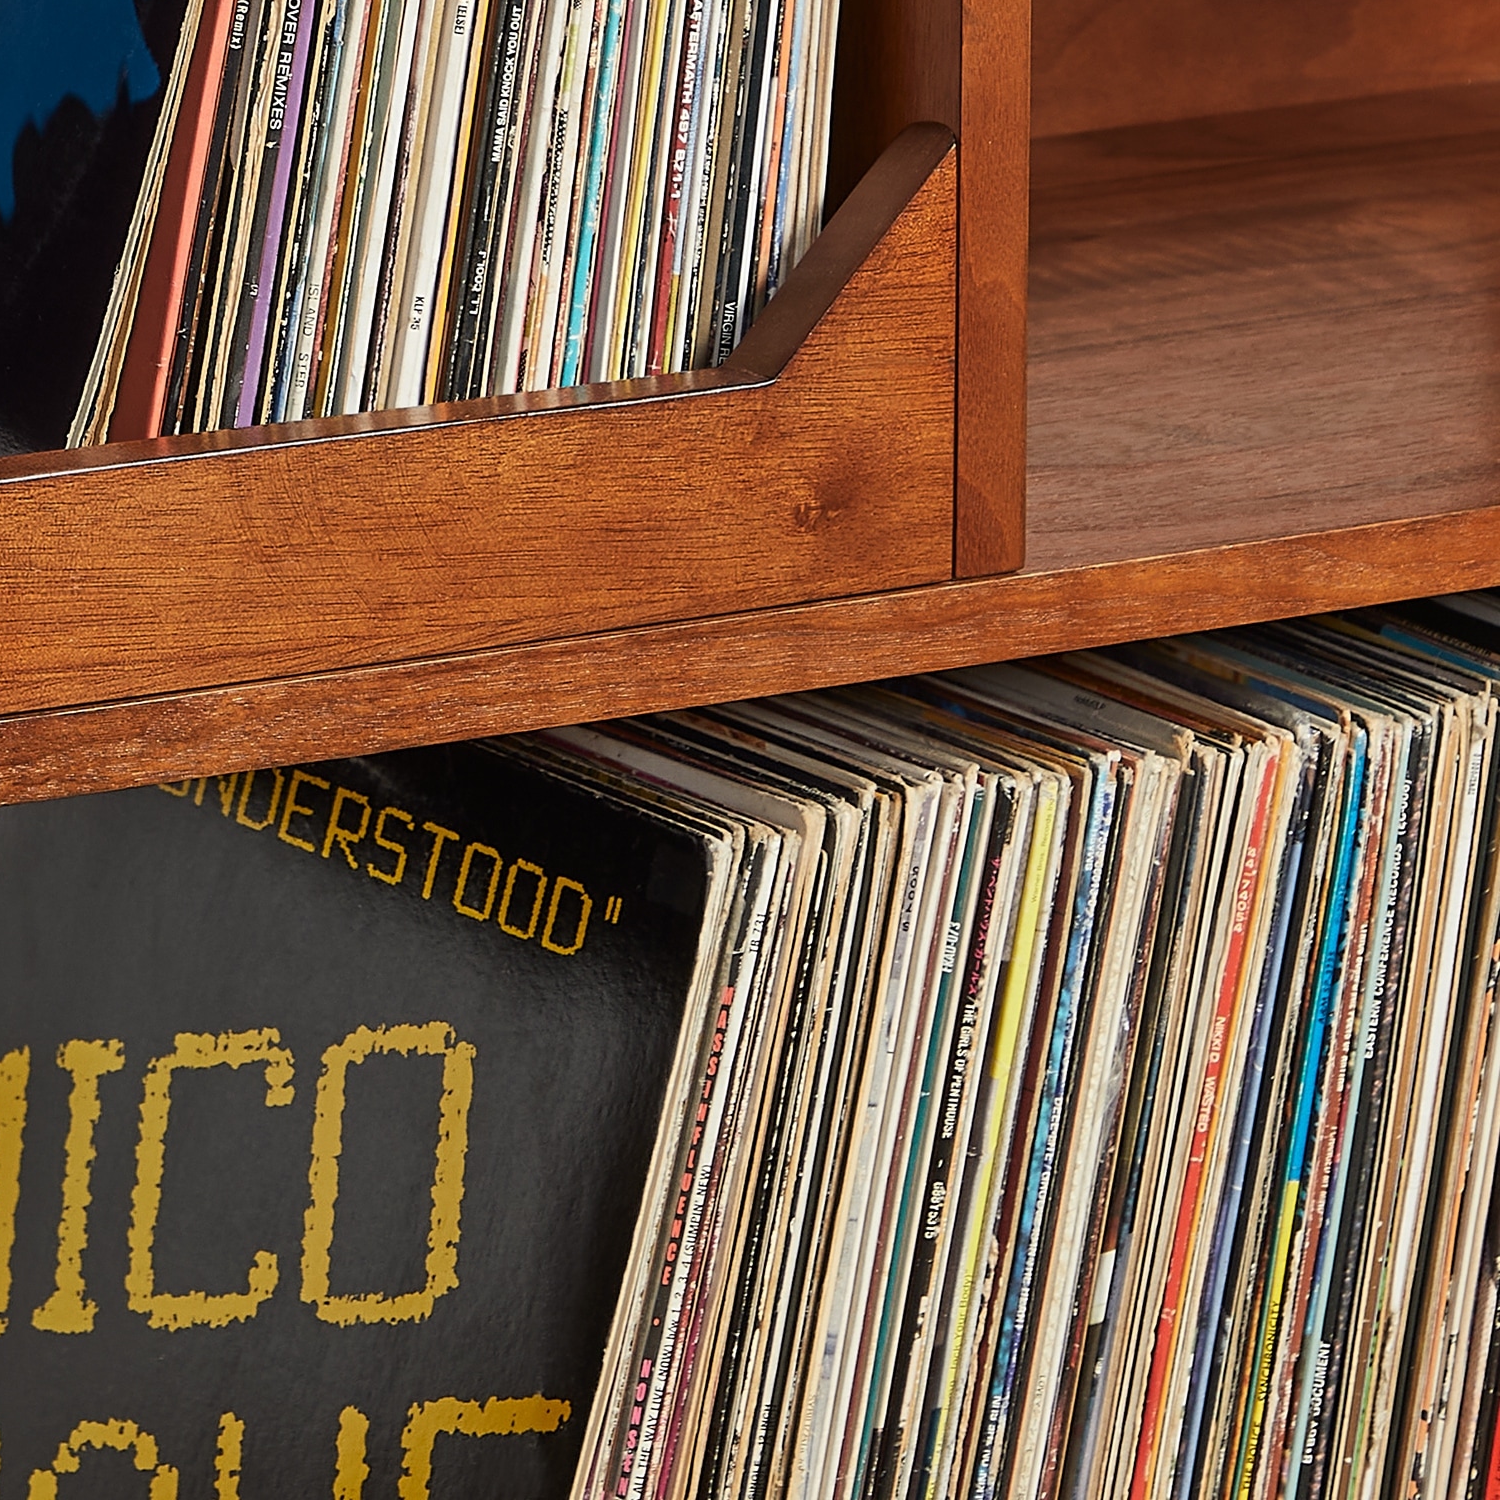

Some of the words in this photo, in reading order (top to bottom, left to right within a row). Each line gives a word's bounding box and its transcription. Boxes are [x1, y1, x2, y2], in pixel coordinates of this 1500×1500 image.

[510, 5, 522, 30] OUT
[506, 31, 518, 56] YOU
[681, 0, 703, 103] AFTERMATH
[271, 51, 291, 129] REMIXES
[501, 57, 514, 96] KNOCK
[496, 98, 509, 125] SAID
[491, 125, 504, 162] MAMA
[473, 261, 486, 291] COOL
[719, 301, 736, 343] VIRGIN
[961, 1003, 975, 1024] THE
[957, 1025, 971, 1056] GIRLS
[1212, 1016, 1226, 1053] NIKKI
[953, 1058, 965, 1073] OF
[943, 1075, 961, 1139] PENTHOUSE
[1197, 1076, 1216, 1133] WASTED
[1313, 1340, 1332, 1416] DOCUMENT
[1364, 999, 1380, 1058] EASTERN
[1373, 909, 1394, 995] CONFERENCE
[1387, 843, 1402, 903] RECORDS
[697, 1163, 710, 1195] NEW)
[684, 1200, 703, 1256] (SUMPIN'
[658, 1343, 672, 1382] (NOW)
[1257, 1301, 1282, 1402] SYNCHRONICITY
[650, 1385, 665, 1413] LIVE
[644, 1415, 658, 1443] WAY
[637, 1446, 652, 1469] THE
